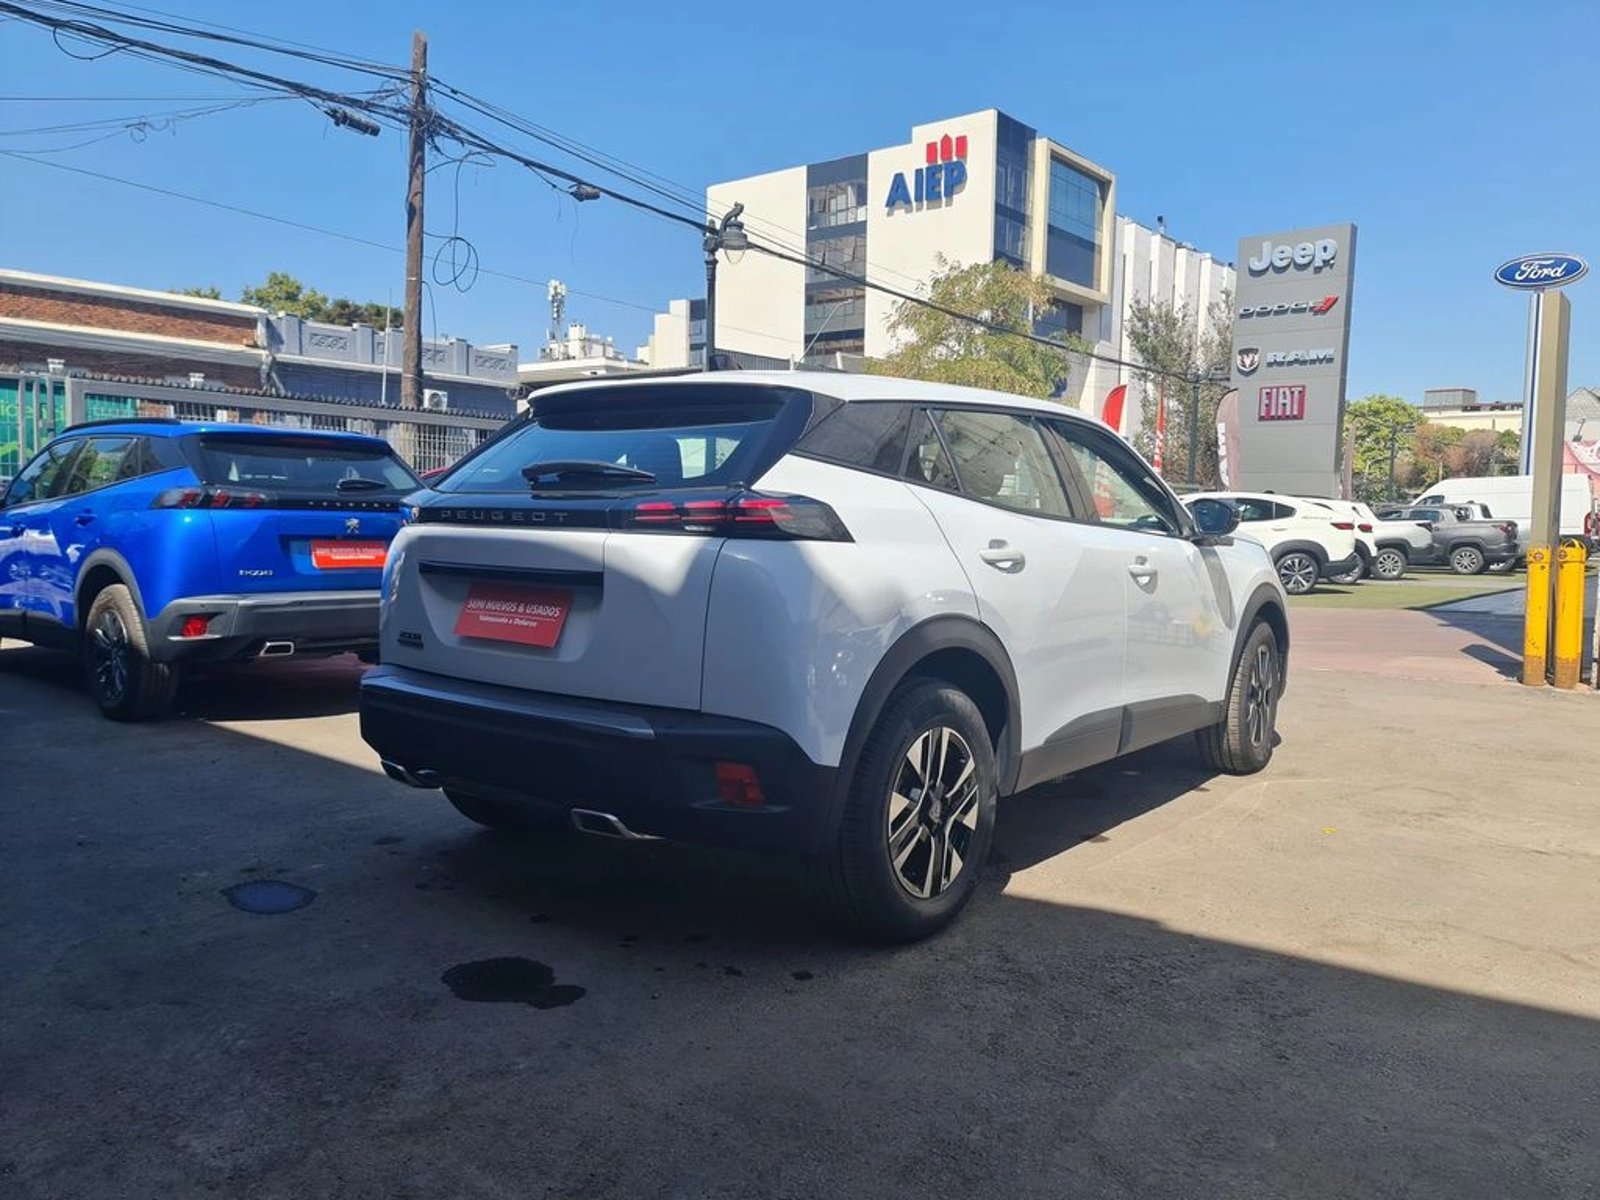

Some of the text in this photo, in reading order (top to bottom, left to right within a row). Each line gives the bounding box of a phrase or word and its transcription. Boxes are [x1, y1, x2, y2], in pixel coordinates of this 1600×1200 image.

[885, 160, 968, 209] AIEP
[1248, 238, 1337, 274] Jeep
[1515, 259, 1568, 281] Ford
[1267, 347, 1335, 367] RAM
[1260, 387, 1304, 418] FIAT
[441, 509, 569, 522] PEUGEOT
[485, 600, 517, 613] NUEVOS
[518, 602, 525, 613] &
[526, 604, 562, 618] USADOS
